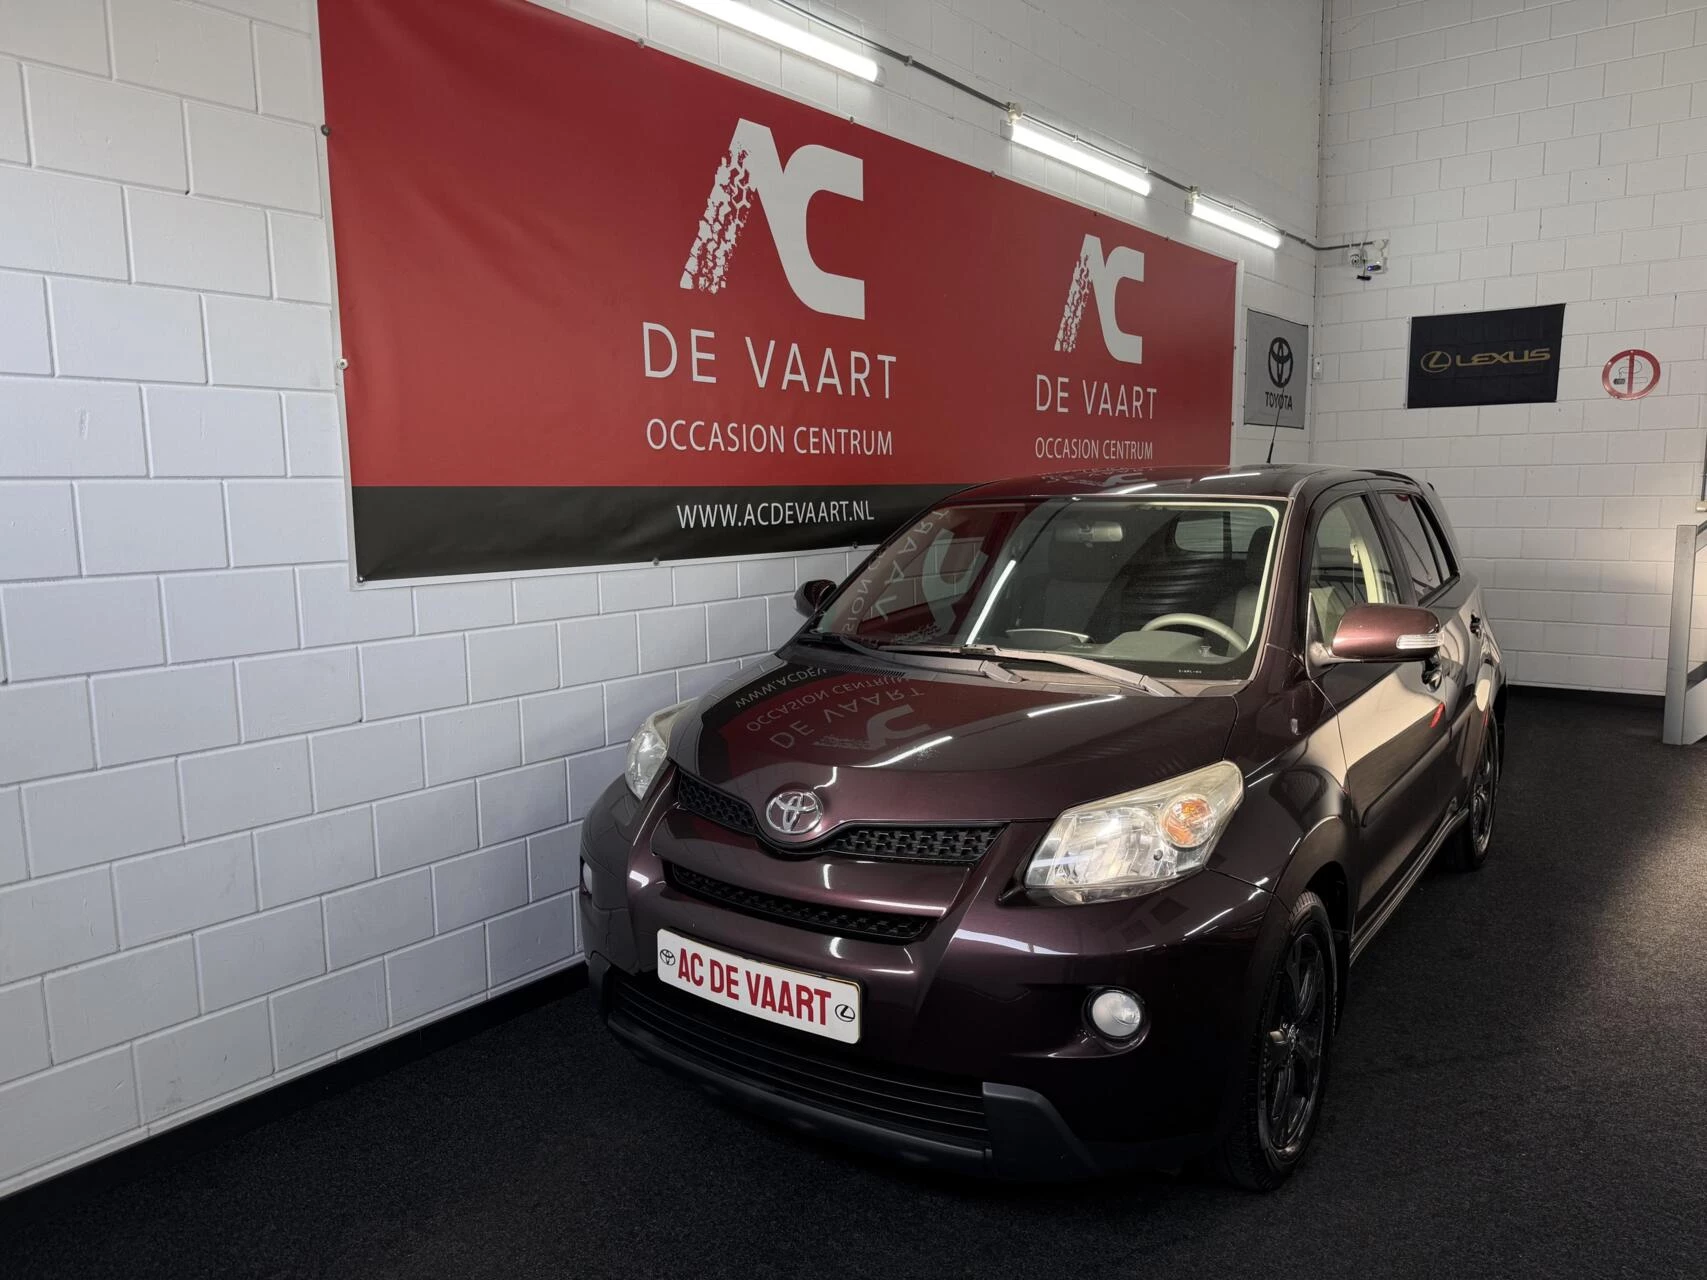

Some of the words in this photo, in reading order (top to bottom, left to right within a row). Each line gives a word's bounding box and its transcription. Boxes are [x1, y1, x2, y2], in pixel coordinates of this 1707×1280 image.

[680, 118, 866, 320] AC
[1054, 233, 1145, 365] AC
[643, 321, 717, 384] DE
[744, 336, 897, 399] VAART
[1455, 347, 1551, 367] LEXUS
[1036, 374, 1069, 413] DE
[1082, 379, 1157, 420] VAART
[1264, 391, 1293, 410] TOYOTA
[646, 418, 784, 453] OCCASION
[793, 426, 893, 456] CENTRUM
[1035, 436, 1098, 459] OCCASION
[1102, 439, 1153, 460] CENTRUM
[676, 500, 875, 529] WWW.ACDEVAART.NL
[678, 948, 704, 987] AC
[709, 958, 740, 1001] DE
[745, 970, 832, 1026] VAART
